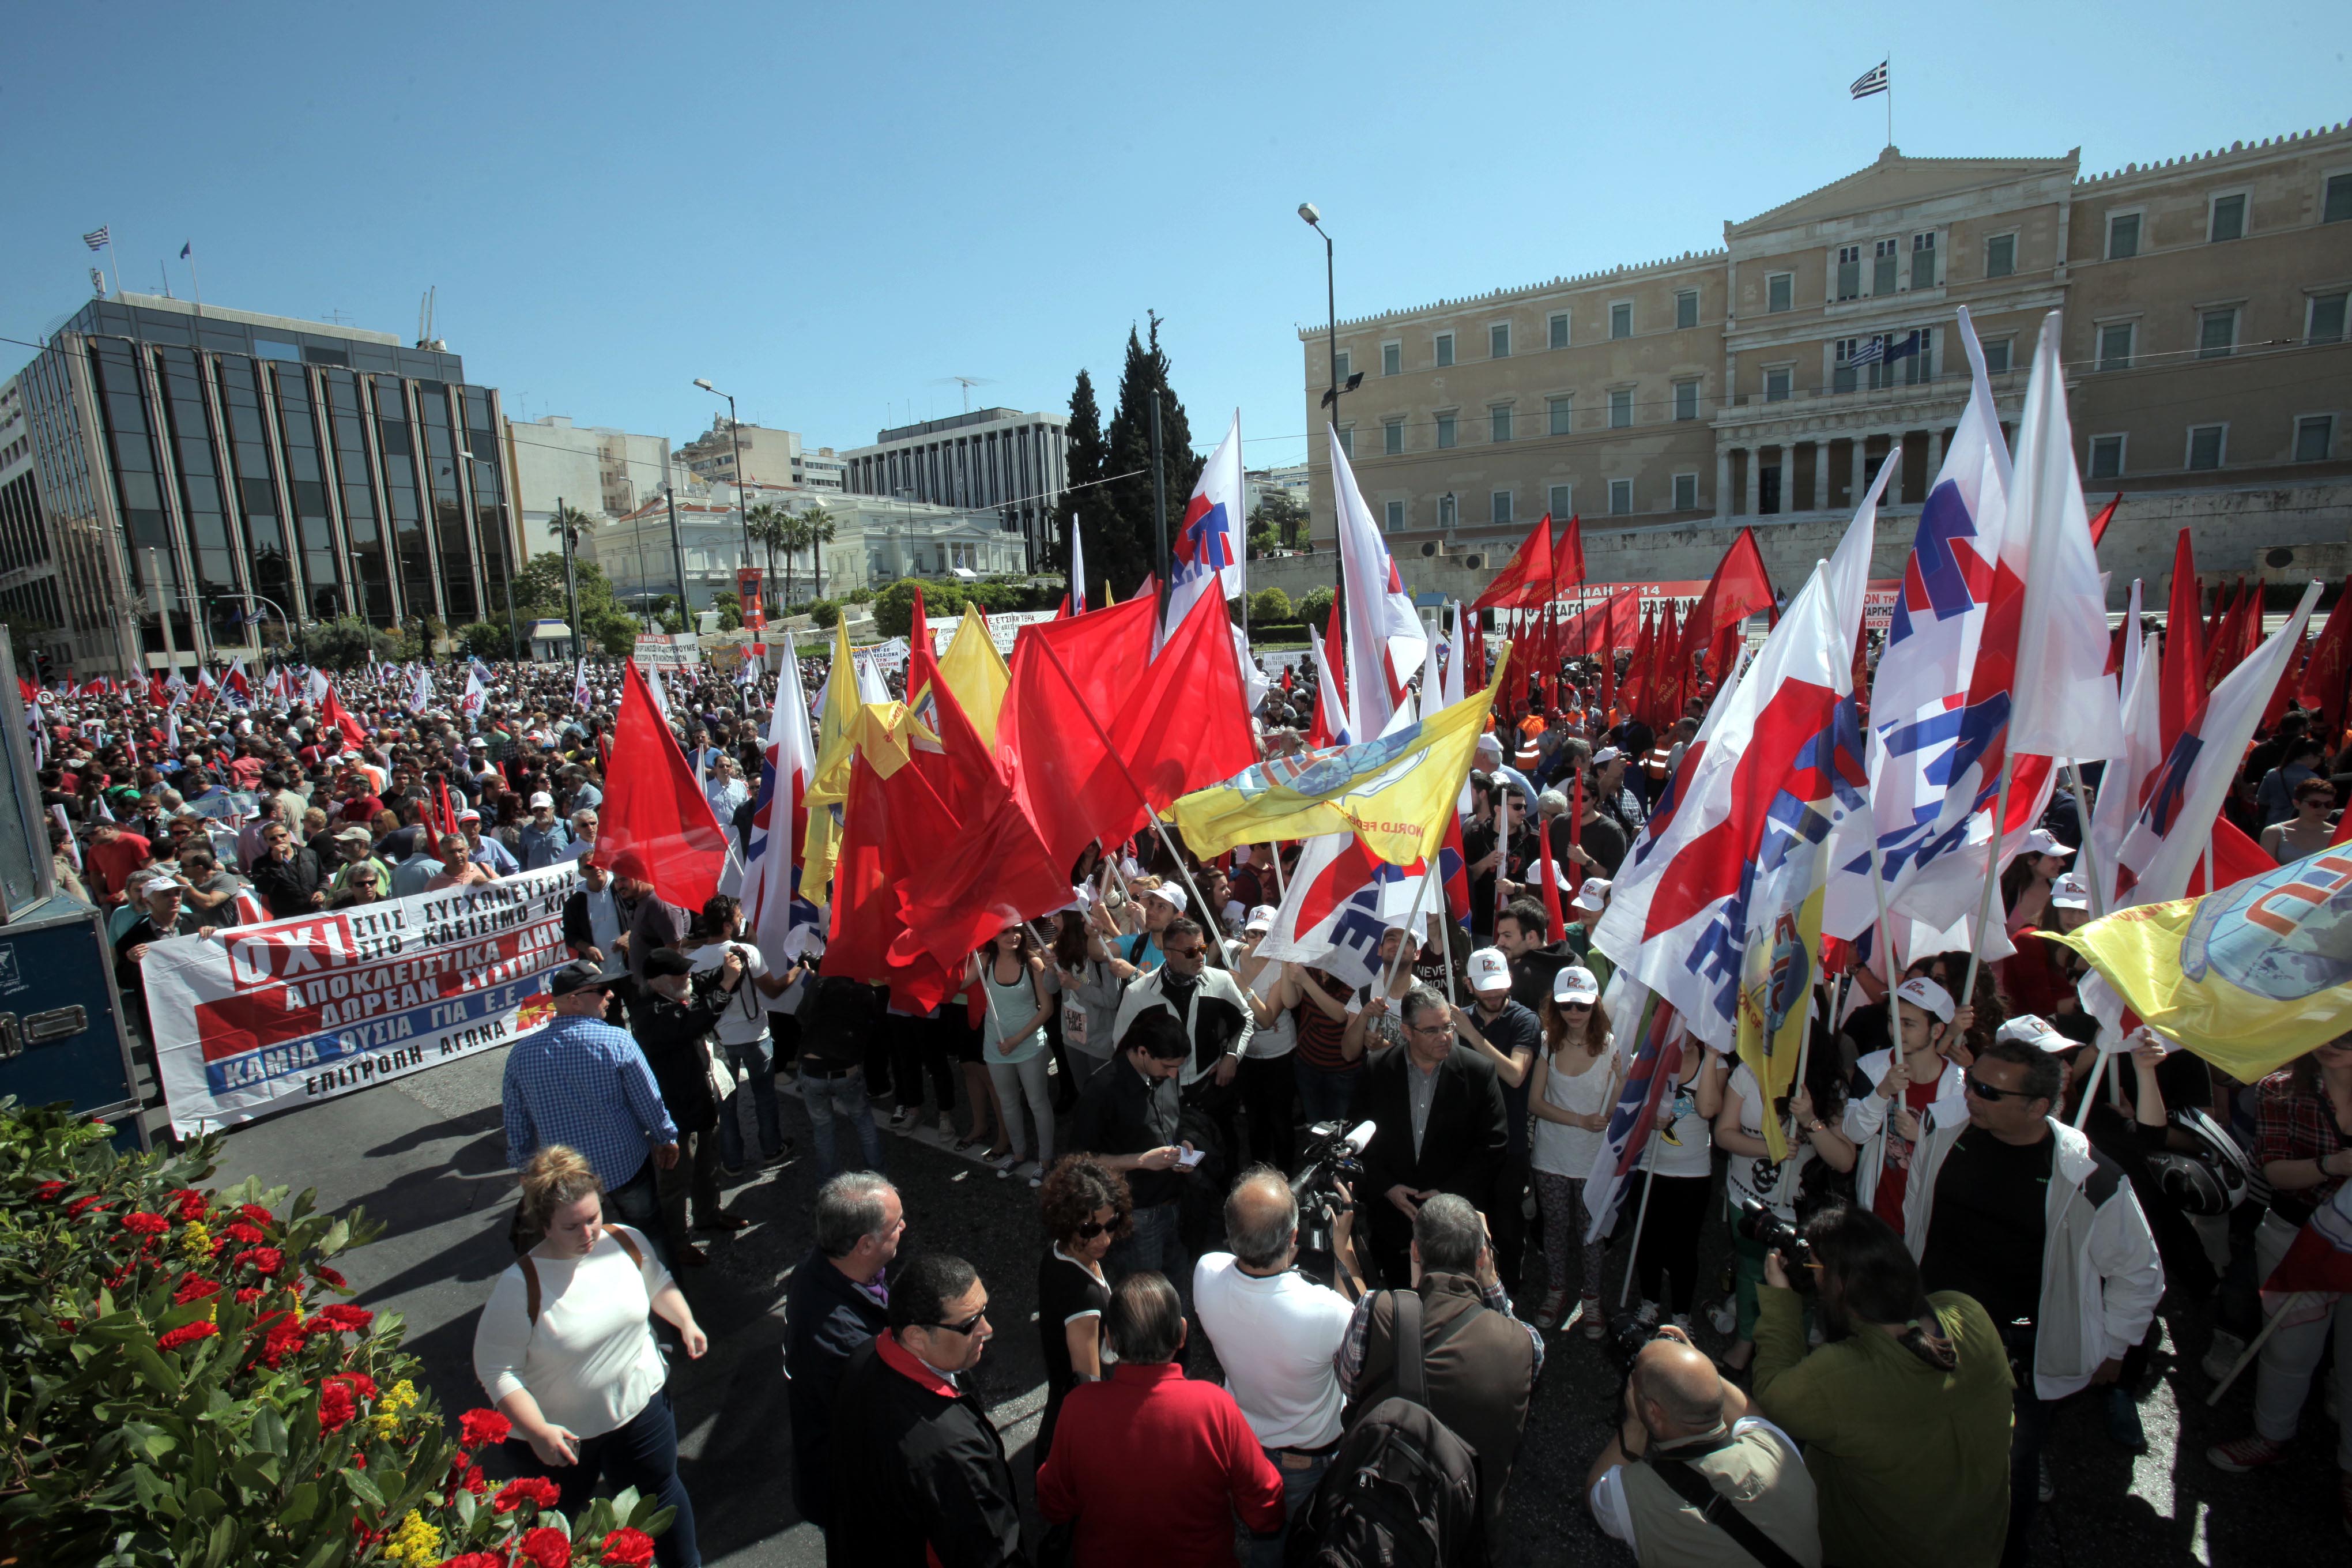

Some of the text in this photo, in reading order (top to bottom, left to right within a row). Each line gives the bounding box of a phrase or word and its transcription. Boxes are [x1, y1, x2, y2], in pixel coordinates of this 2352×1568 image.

[996, 616, 1012, 624] ΕΤΣΙ
[1578, 586, 1614, 598] ΜΑΗ
[1621, 585, 1660, 596] 214
[231, 869, 575, 985] ΟΧΙ ΣΤΙΣ ΣΥΓΧΩΝΕΥΣΕΙΣ
[359, 934, 403, 961] ΣΤΟ
[423, 904, 528, 947] ΚΛΕΙΣΙΜΟ
[285, 941, 501, 1012] ΑΠΟΚΛΕΙΣΤΙΚΑ
[321, 942, 570, 1028] ΔΩΡΕΑΝ ΣΥΣΤΗΜΑ
[1416, 964, 1449, 978] NEVE
[224, 1041, 321, 1090] ΚΑΜΙΑ
[431, 1001, 469, 1028] ΓΙΑ
[485, 986, 524, 1013] Ε.Ε.
[306, 1020, 508, 1096] ΕΠΙΤΡΟΠΗ ΑΓΩΝΑ
